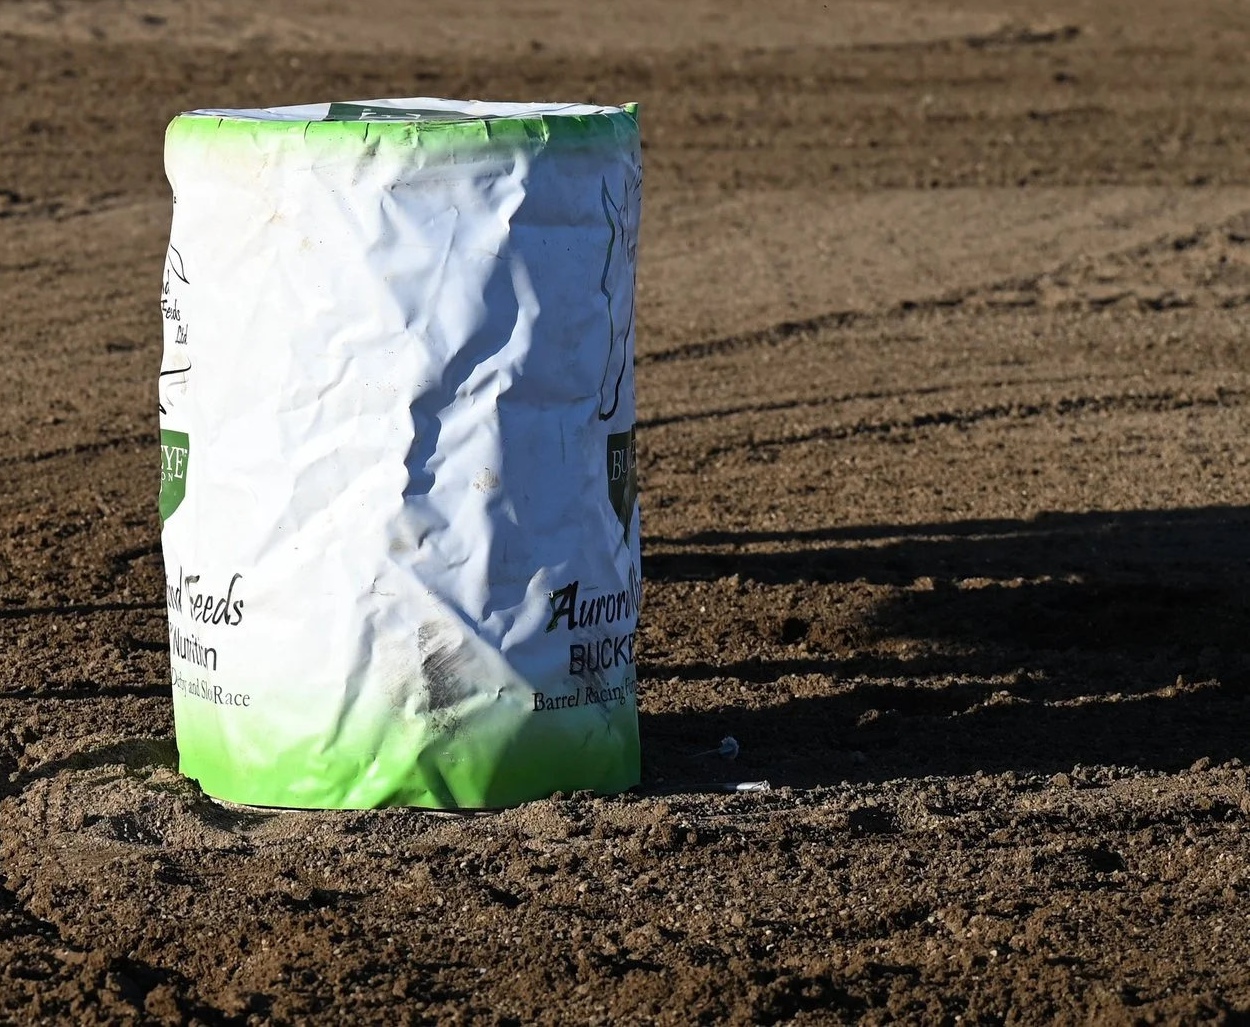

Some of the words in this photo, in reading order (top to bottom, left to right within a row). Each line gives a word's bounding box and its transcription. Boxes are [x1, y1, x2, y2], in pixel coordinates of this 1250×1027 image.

[184, 572, 244, 626] Feeds
[213, 685, 250, 707] Race
[532, 688, 580, 711] Barrel
